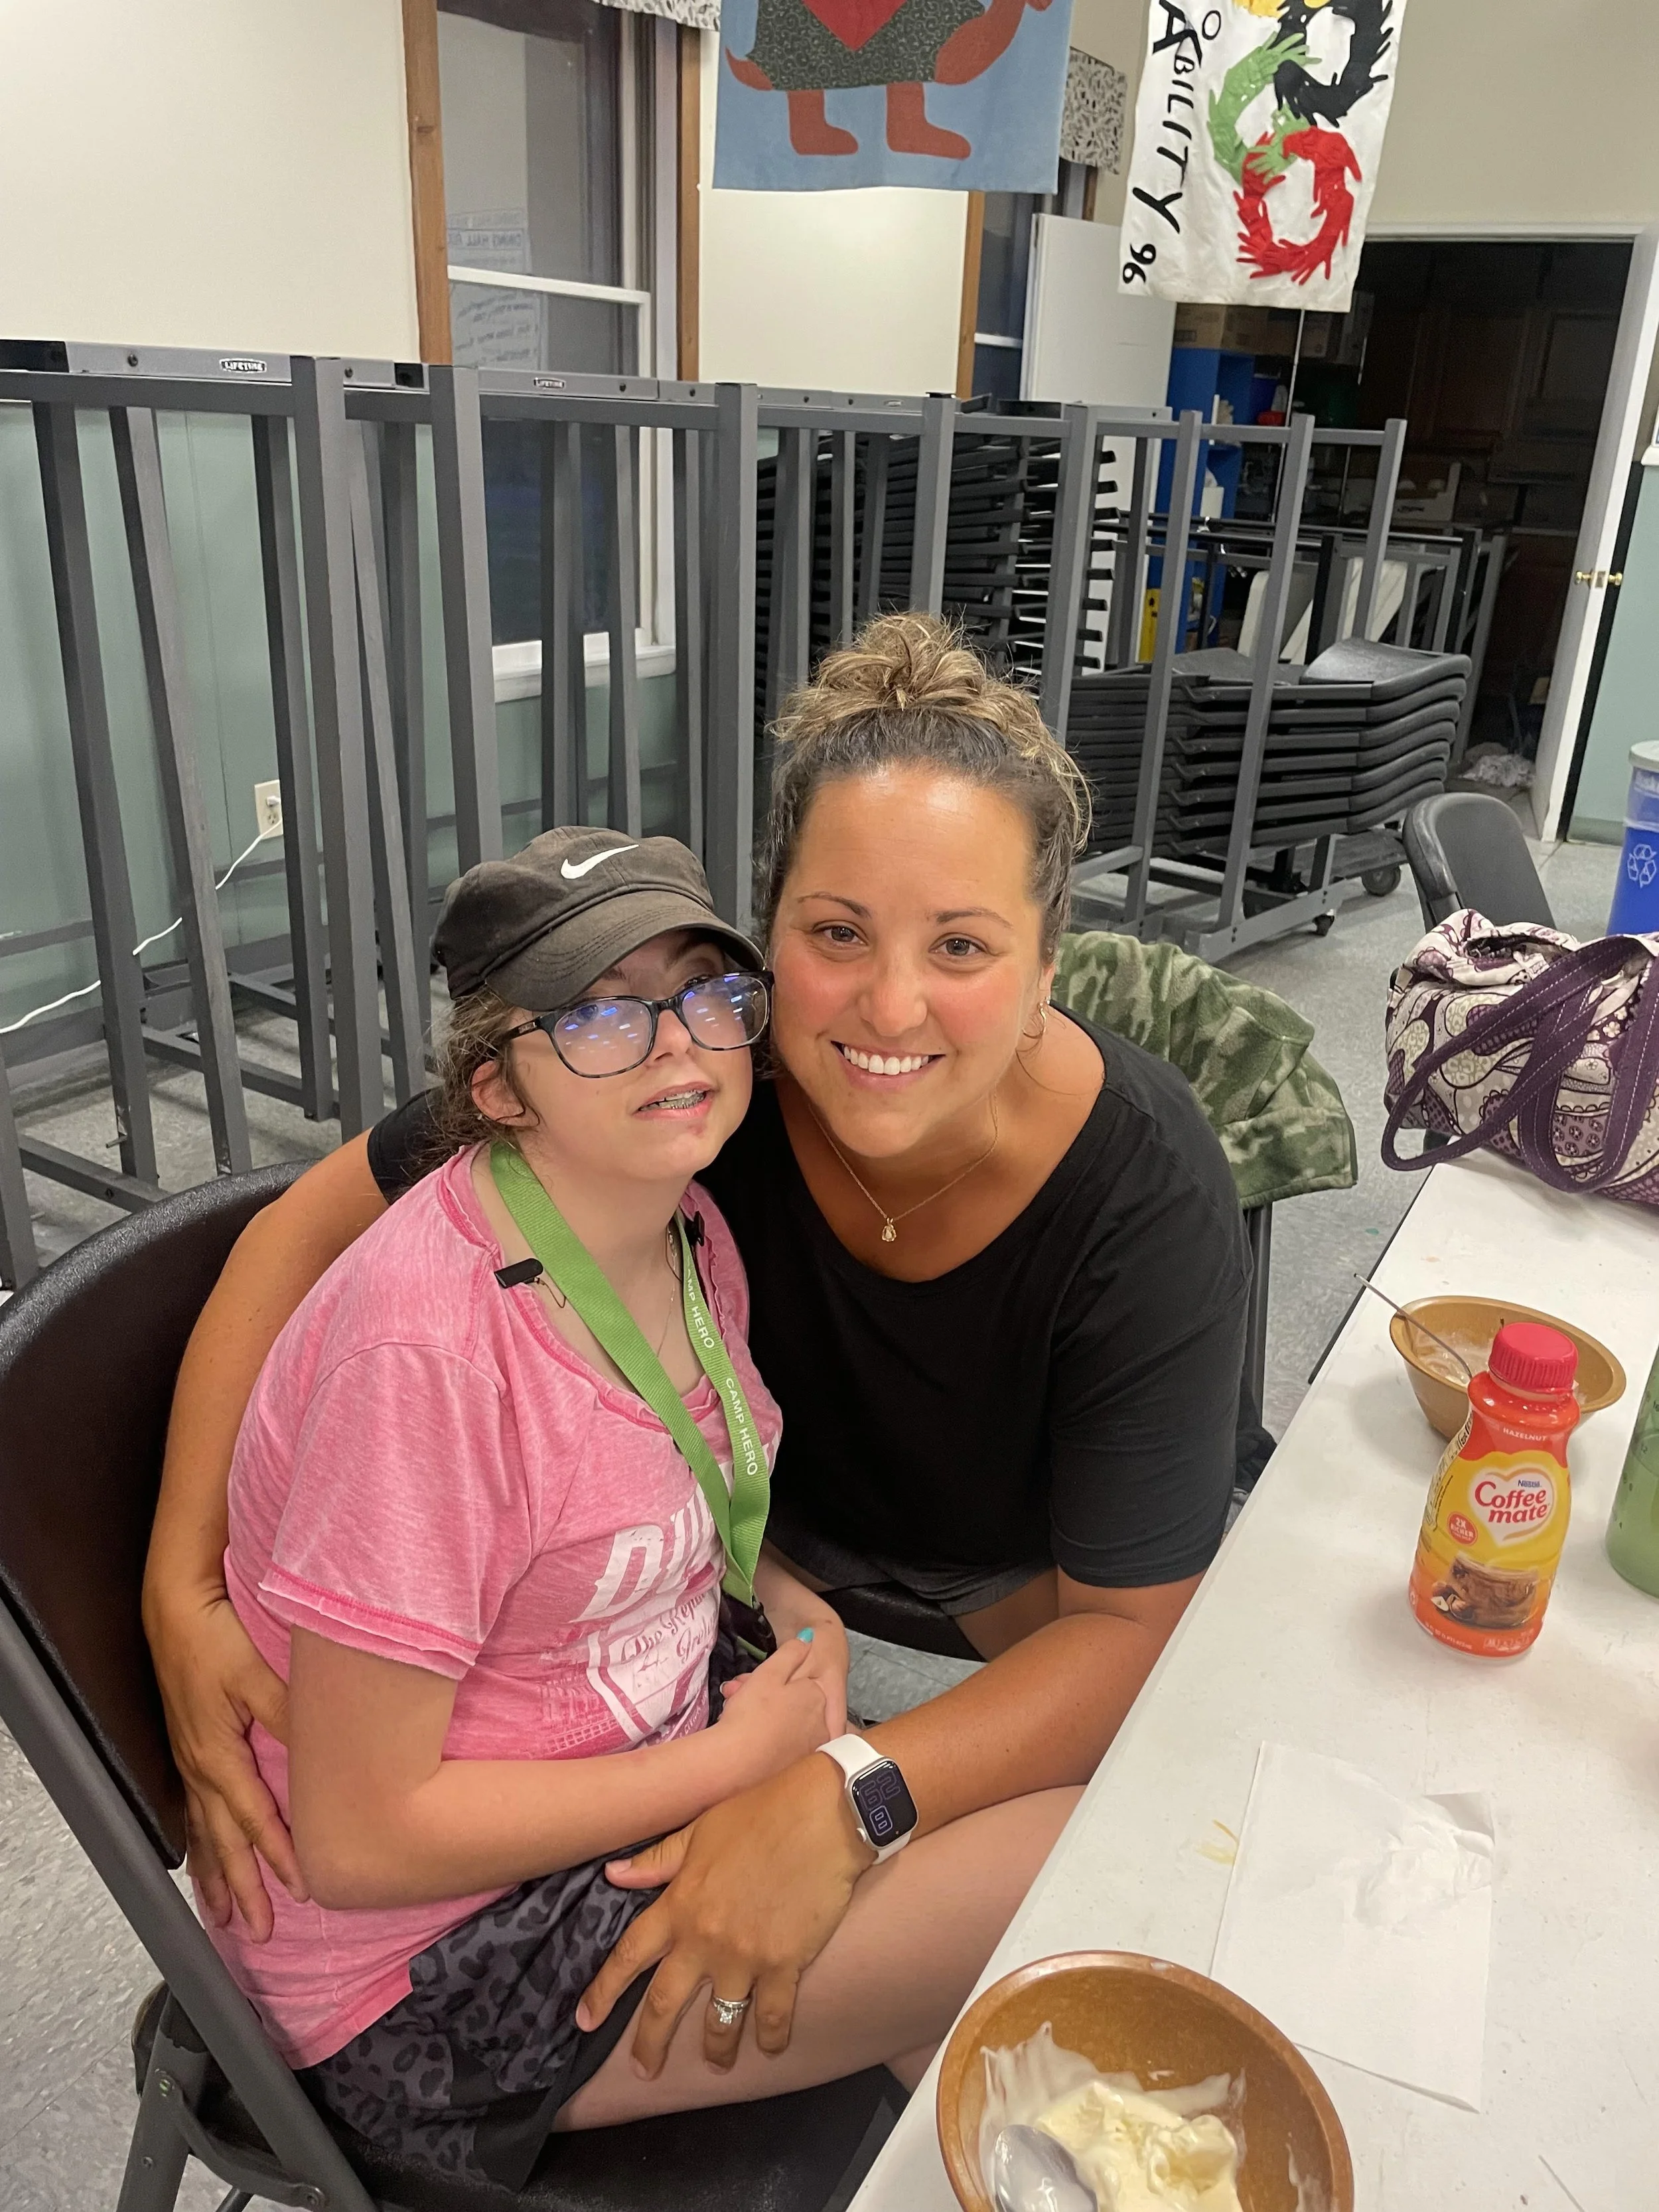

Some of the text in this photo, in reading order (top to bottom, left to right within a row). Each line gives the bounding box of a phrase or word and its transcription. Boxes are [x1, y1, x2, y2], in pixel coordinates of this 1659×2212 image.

[1123, 243, 1156, 284] 96
[691, 1305, 715, 1349] HERO
[726, 1378, 758, 1476] CAMP HERO
[1503, 1427, 1547, 1441] HAZELNUT
[1475, 1481, 1547, 1509] Coffee
[1455, 1517, 1467, 1530] 2X
[1488, 1504, 1548, 1523] mate
